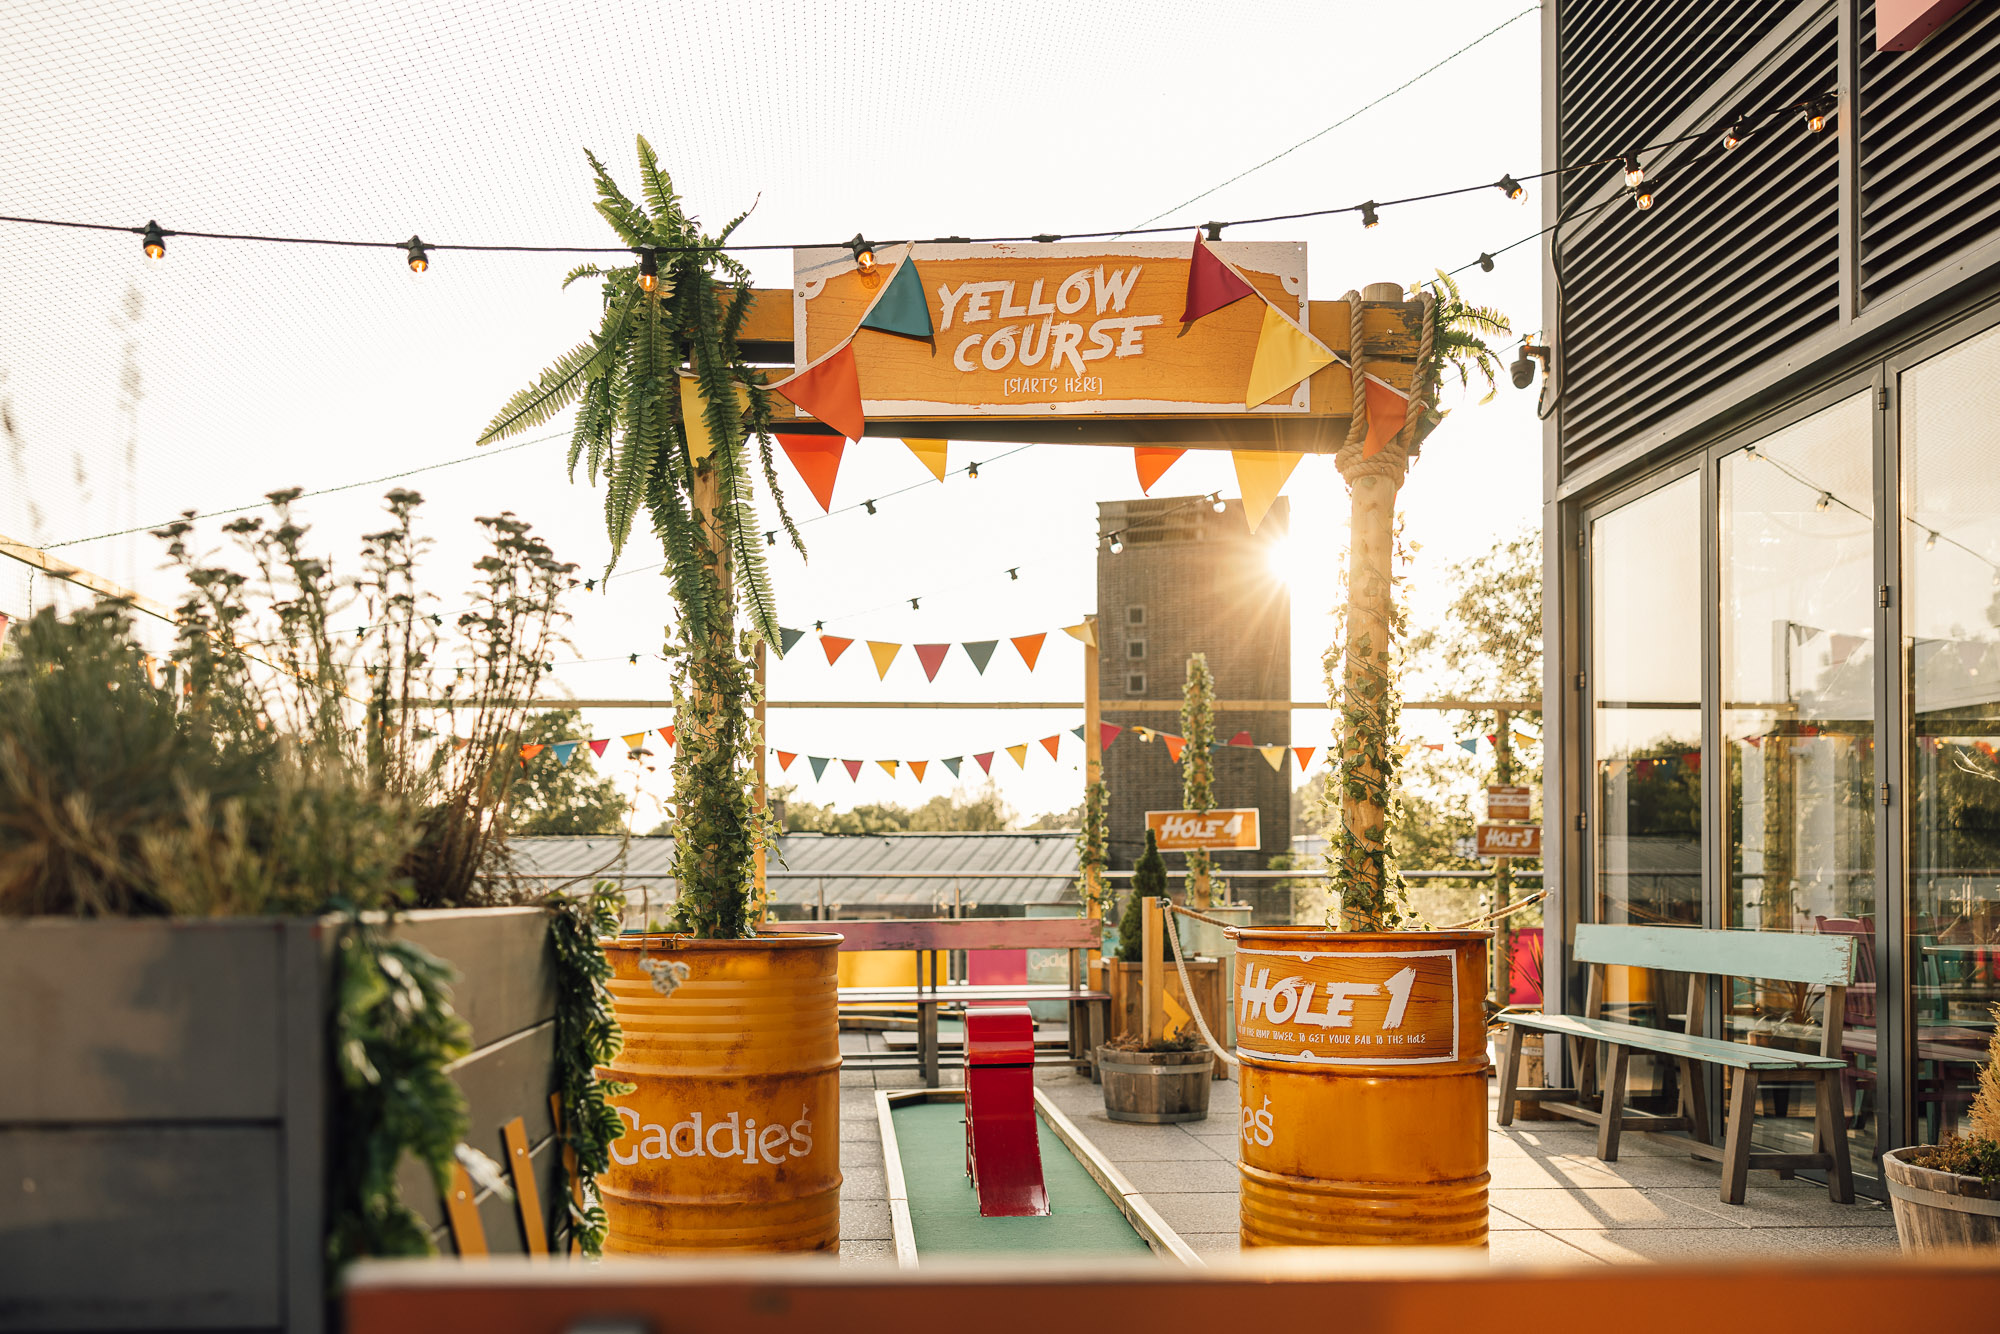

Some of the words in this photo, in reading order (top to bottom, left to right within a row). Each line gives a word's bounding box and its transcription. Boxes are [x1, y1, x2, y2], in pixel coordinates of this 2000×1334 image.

[937, 264, 1143, 333] YELLOW
[953, 313, 1164, 377] COURSE
[1160, 815, 1225, 841] HOLE
[1223, 814, 1244, 837] 4
[1485, 828, 1523, 848] HOLE
[1240, 962, 1382, 1029] HOLE
[1382, 965, 1416, 1030] 1
[1255, 1028, 1270, 1040] RAMP
[1298, 1032, 1306, 1043] TO
[1308, 1033, 1326, 1044] GET
[1329, 1034, 1351, 1045] YOUR
[1354, 1034, 1372, 1045] BALL
[1376, 1034, 1383, 1045] TO
[1387, 1034, 1404, 1045] THE
[609, 1103, 813, 1166] Caddies
